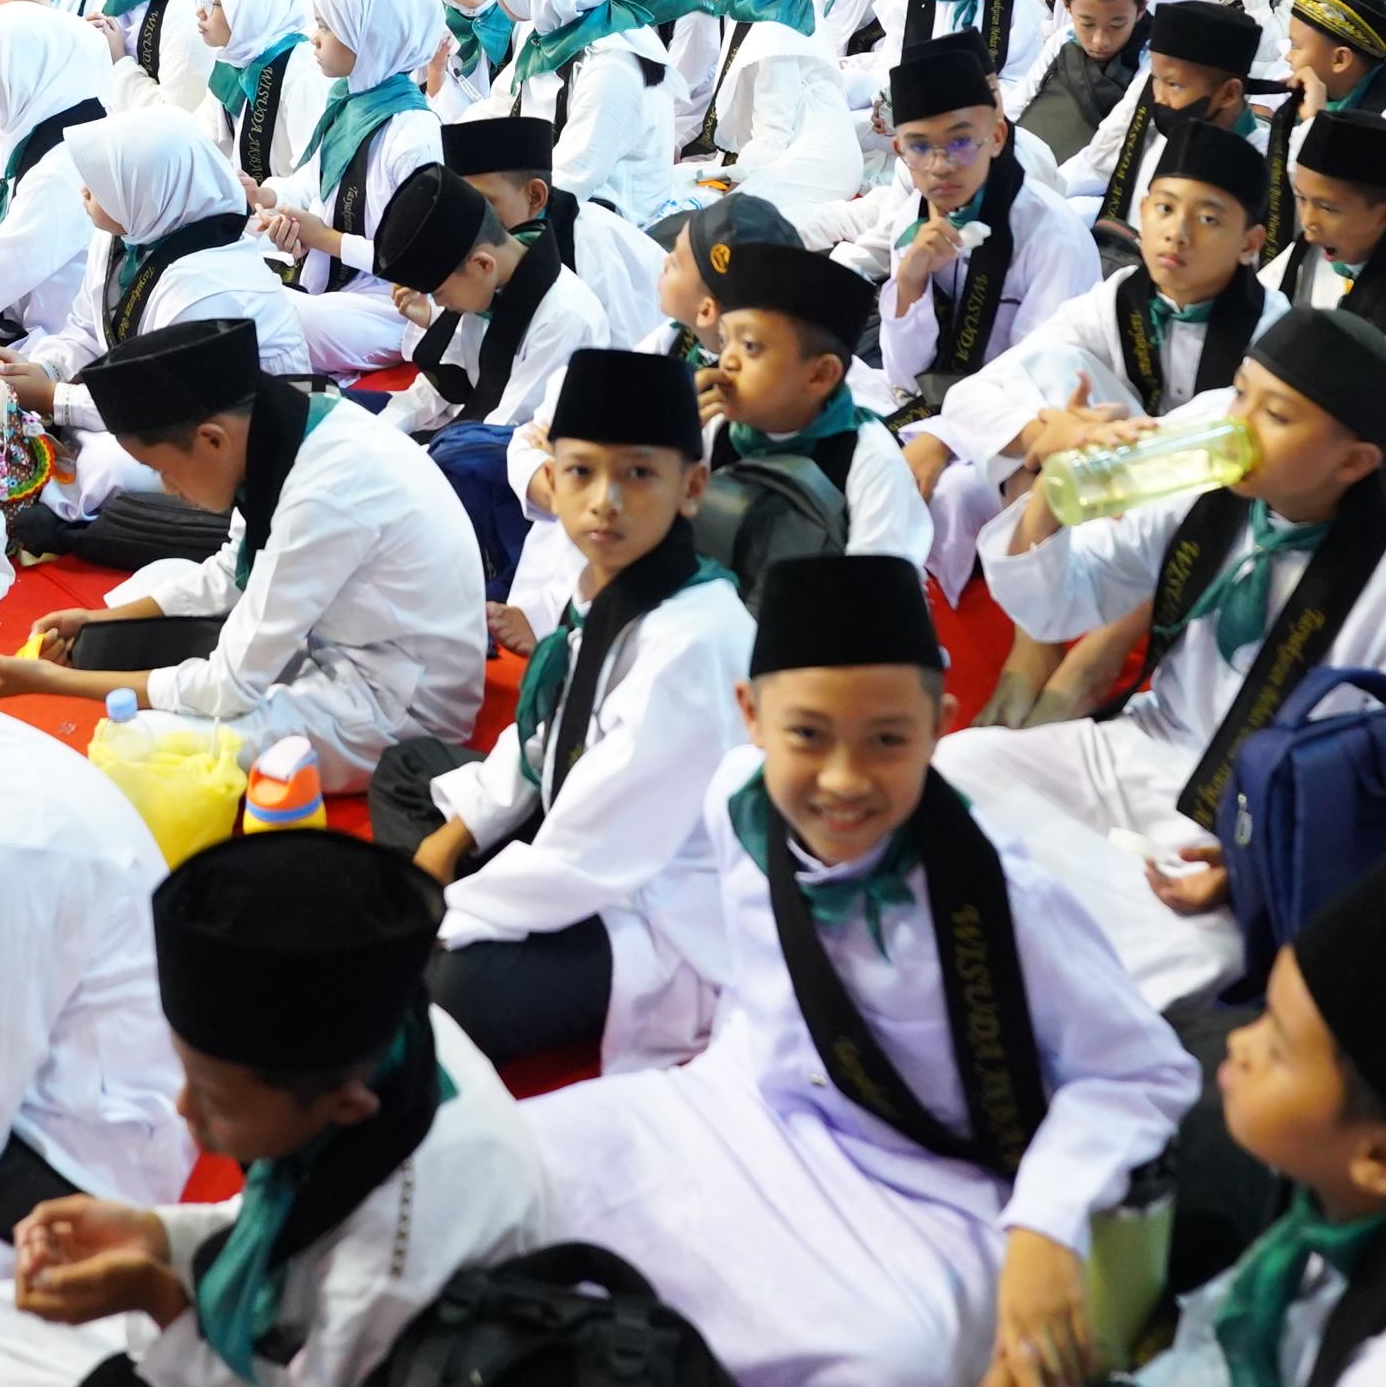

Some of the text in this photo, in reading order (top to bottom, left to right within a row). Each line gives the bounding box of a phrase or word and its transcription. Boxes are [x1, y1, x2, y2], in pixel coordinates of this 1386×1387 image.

[250, 66, 274, 134] WISUDA
[956, 274, 990, 363] WISUDA
[951, 904, 1003, 1060] WISUDA
